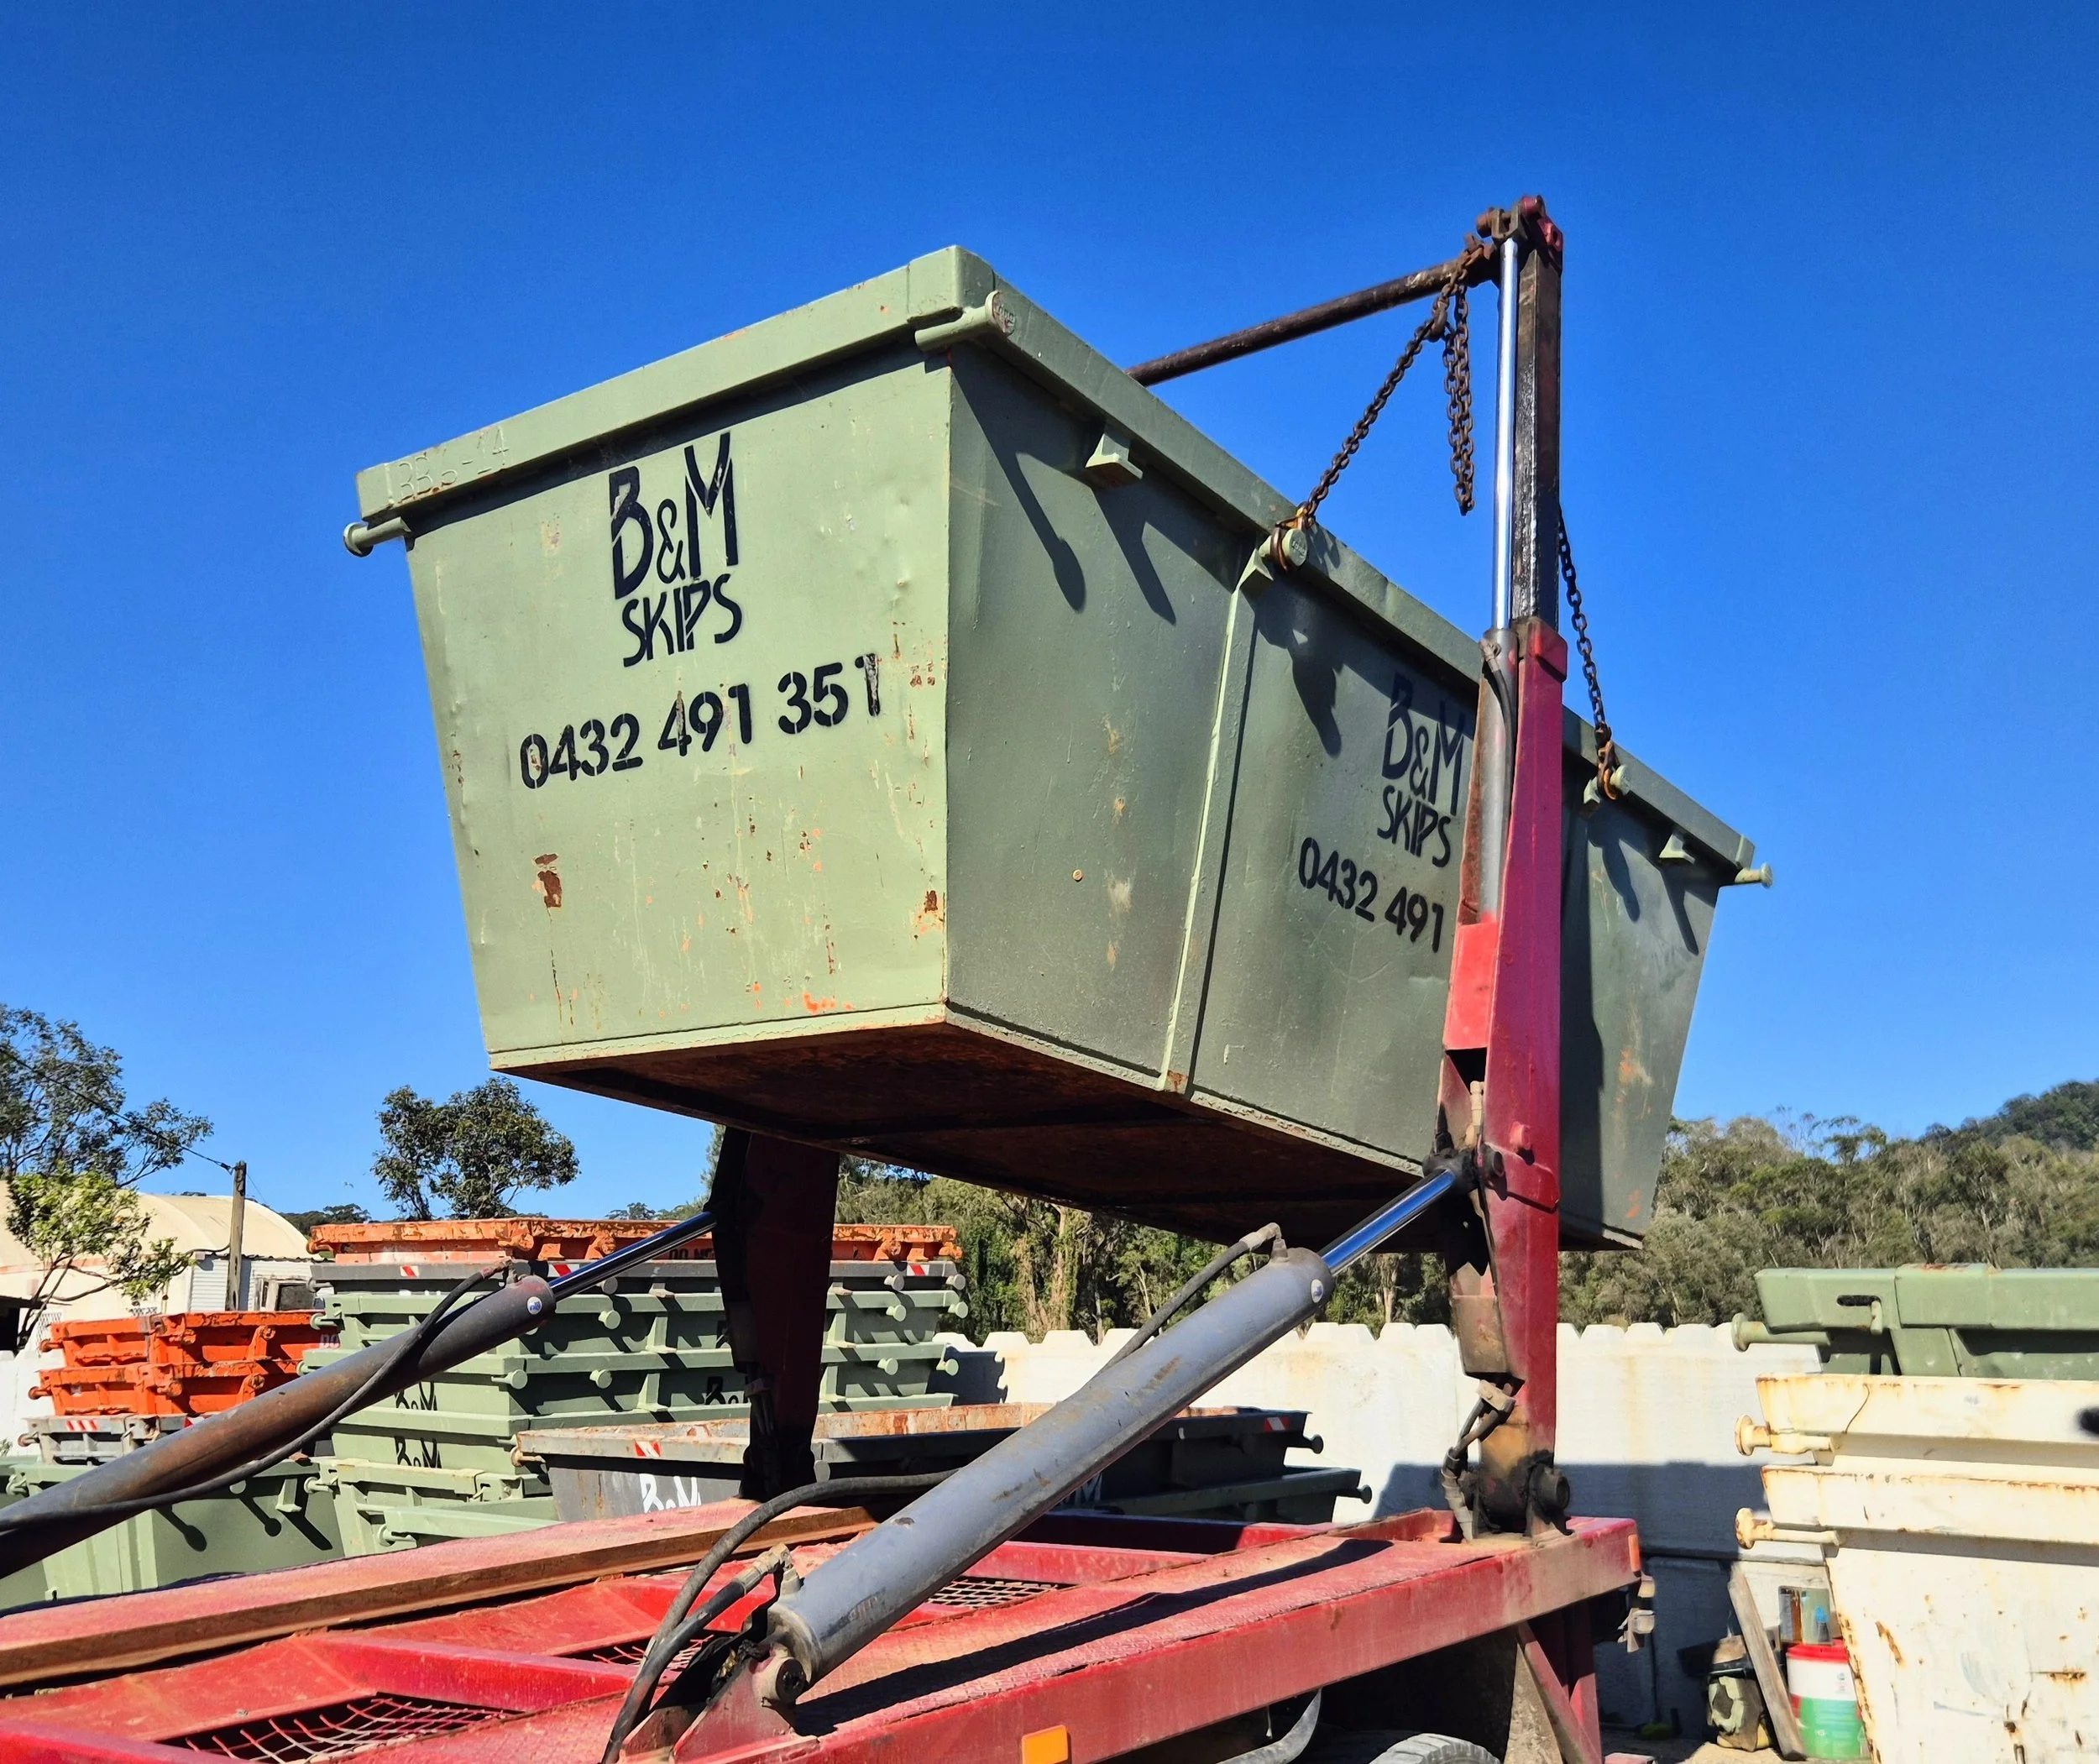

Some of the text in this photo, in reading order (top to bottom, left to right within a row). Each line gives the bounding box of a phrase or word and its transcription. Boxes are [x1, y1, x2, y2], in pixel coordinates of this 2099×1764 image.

[609, 432, 739, 600] B&M
[623, 573, 743, 667] SKIPS
[520, 652, 882, 789] 0432 491 351
[1382, 671, 1466, 817] B&M
[1377, 784, 1451, 868] SKIPS
[1298, 837, 1444, 954] 0432 491
